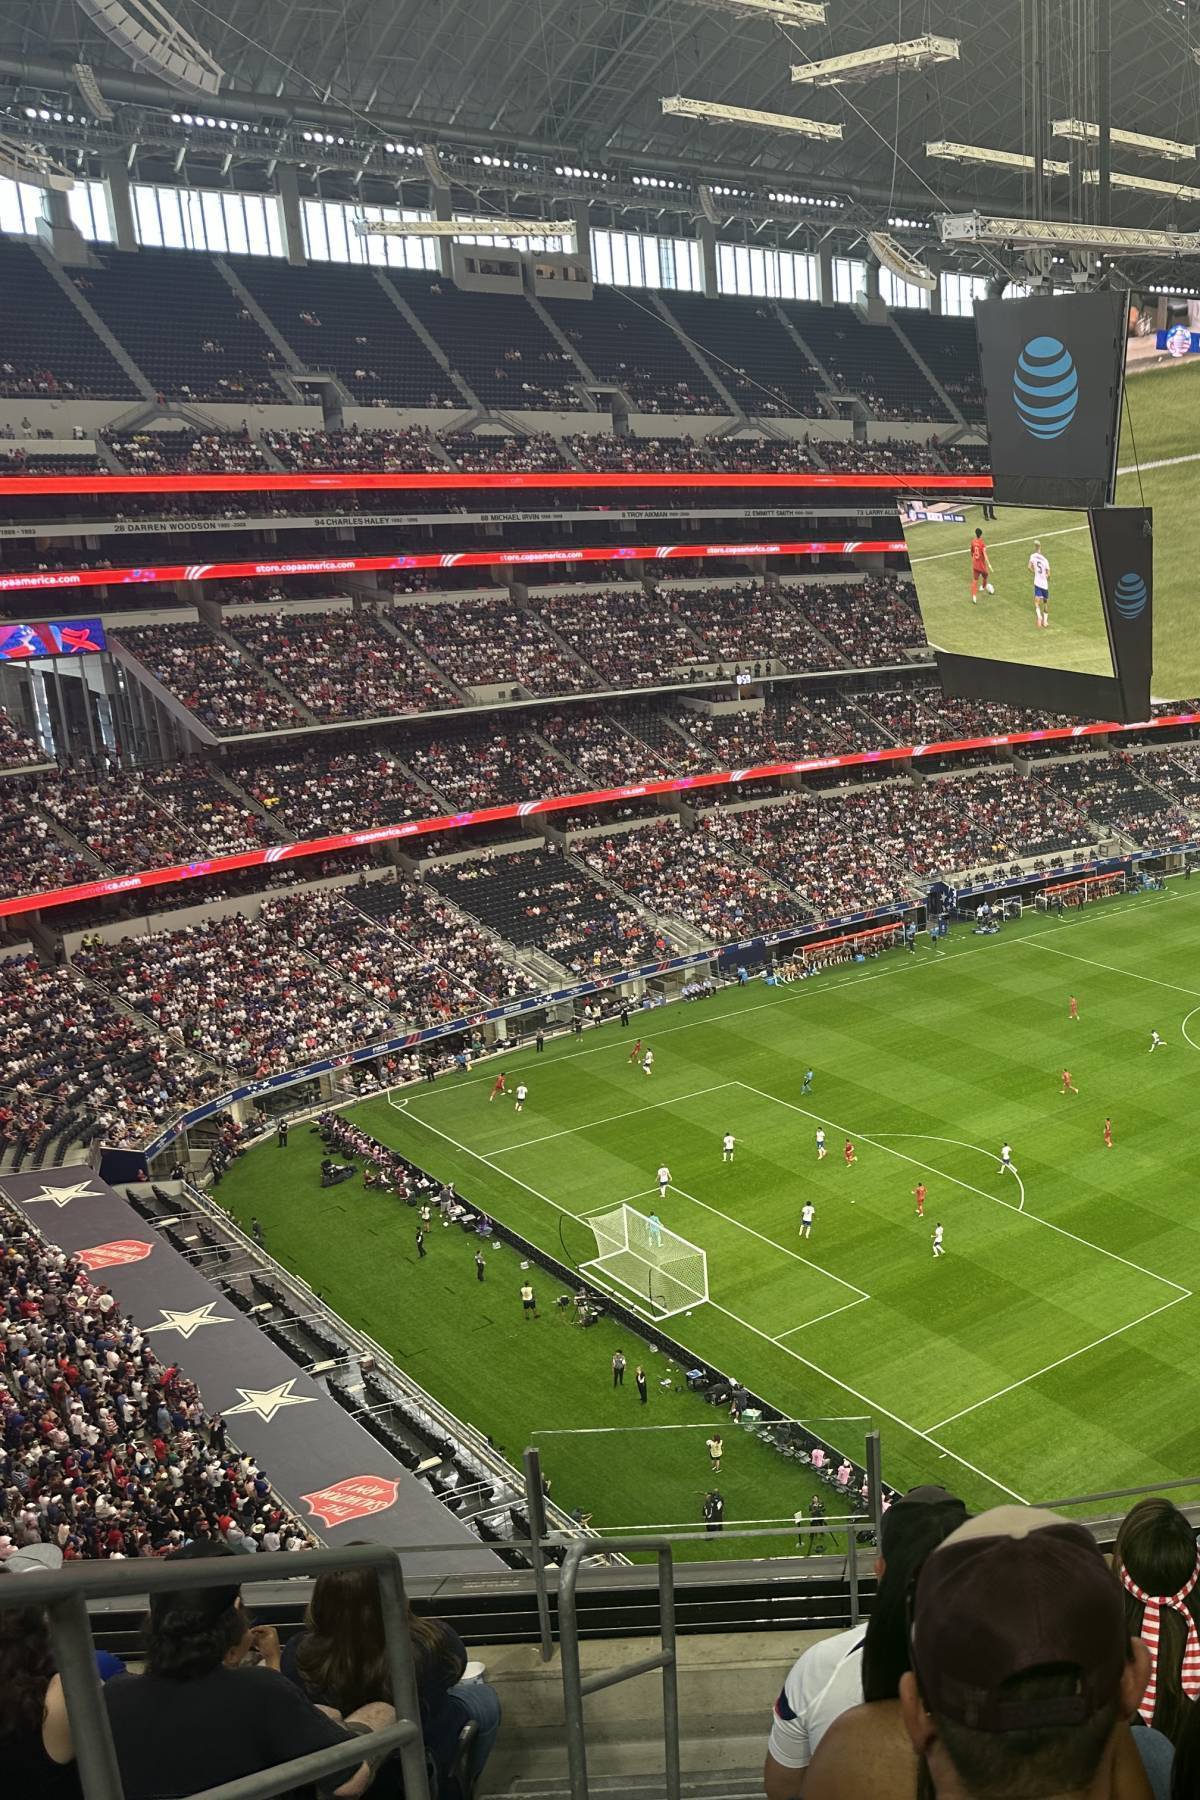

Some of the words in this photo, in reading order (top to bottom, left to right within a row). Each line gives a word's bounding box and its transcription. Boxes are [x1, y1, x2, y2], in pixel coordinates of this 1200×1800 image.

[114, 524, 125, 532] 28
[127, 524, 167, 532] DARREN
[169, 522, 216, 531] WOODSON
[314, 518, 325, 526] 94
[326, 518, 363, 526] CHARLES
[364, 517, 391, 525] HALEY
[256, 560, 355, 573] store.copaamerica.com
[1037, 561, 1044, 574] 5
[338, 1483, 392, 1496] ARMY
[312, 1490, 388, 1511] SALVATION
[319, 1503, 355, 1516] THE
